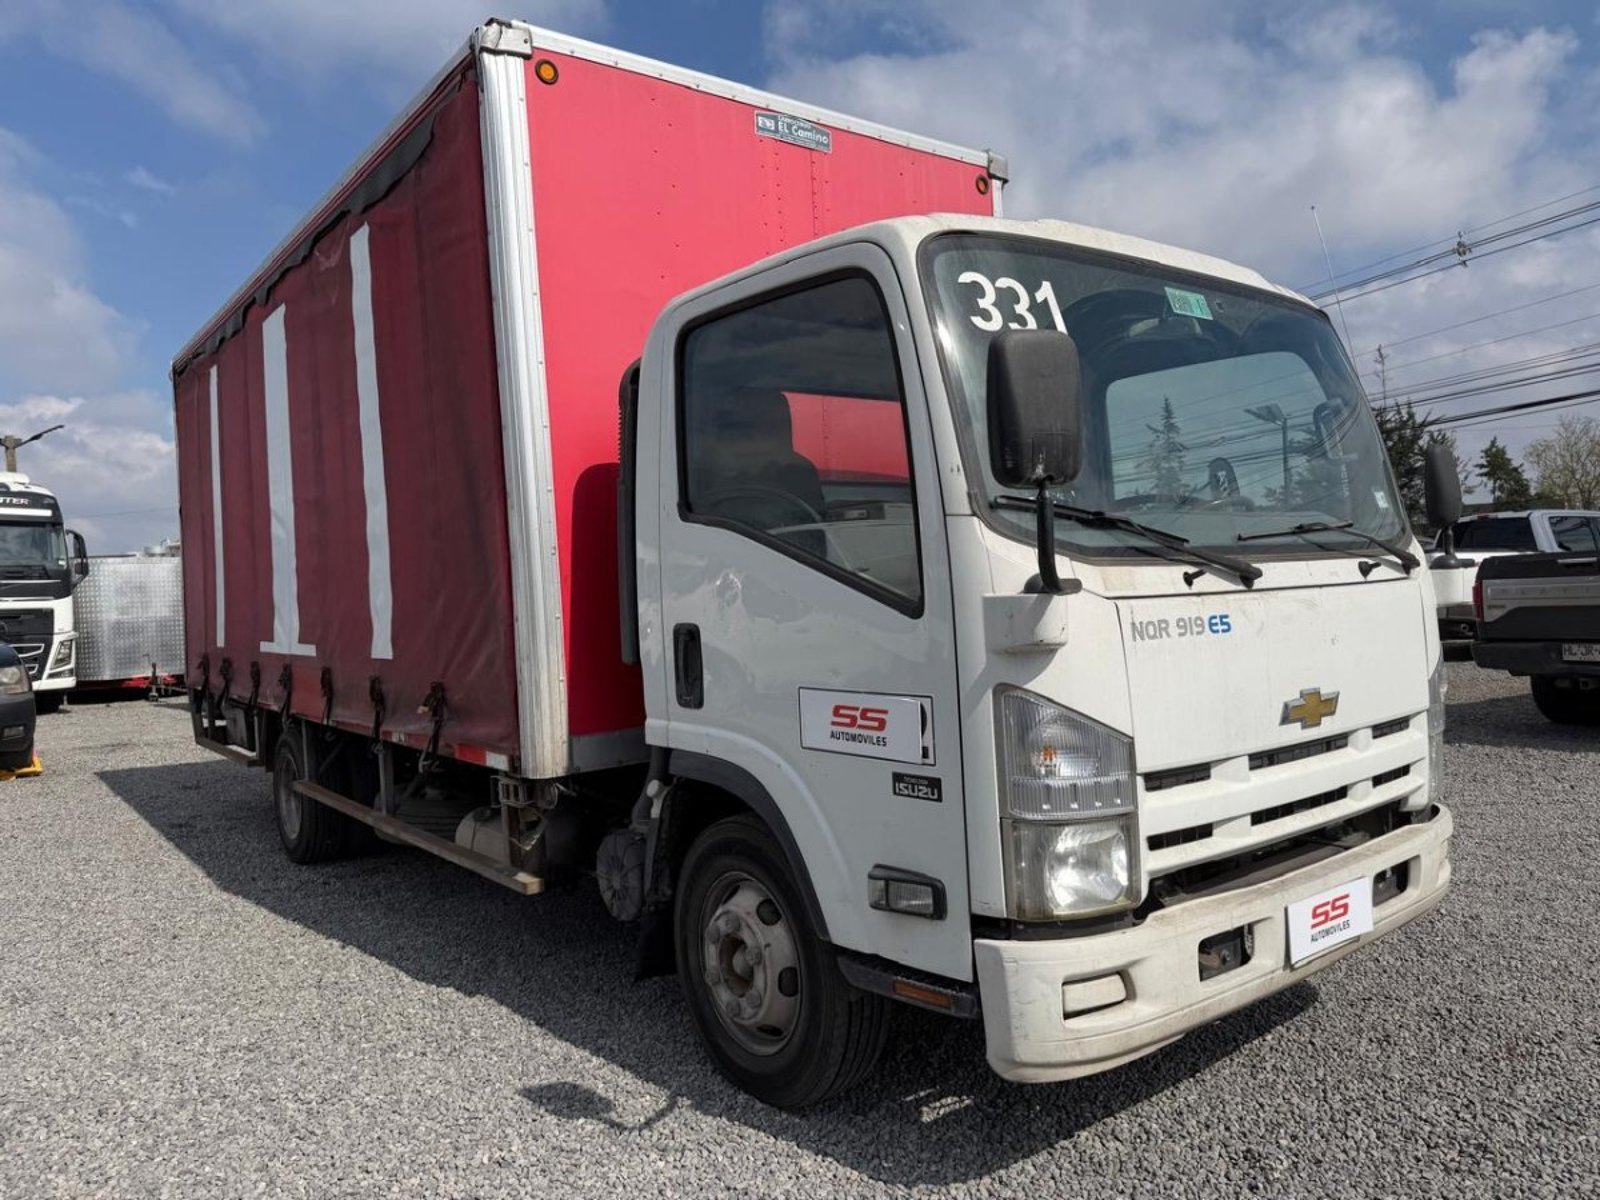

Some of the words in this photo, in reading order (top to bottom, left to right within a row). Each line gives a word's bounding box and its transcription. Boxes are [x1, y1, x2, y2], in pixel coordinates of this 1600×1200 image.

[791, 125, 829, 144] Camino
[957, 271, 1069, 336] 331
[1131, 620, 1170, 642] NQR
[1175, 616, 1205, 637] 919
[830, 704, 889, 733] SS
[829, 730, 888, 747] AUTOMOVILES
[895, 782, 938, 800] ISUZU
[1310, 893, 1350, 929] SS
[1310, 919, 1351, 943] AUTOMOVILES
